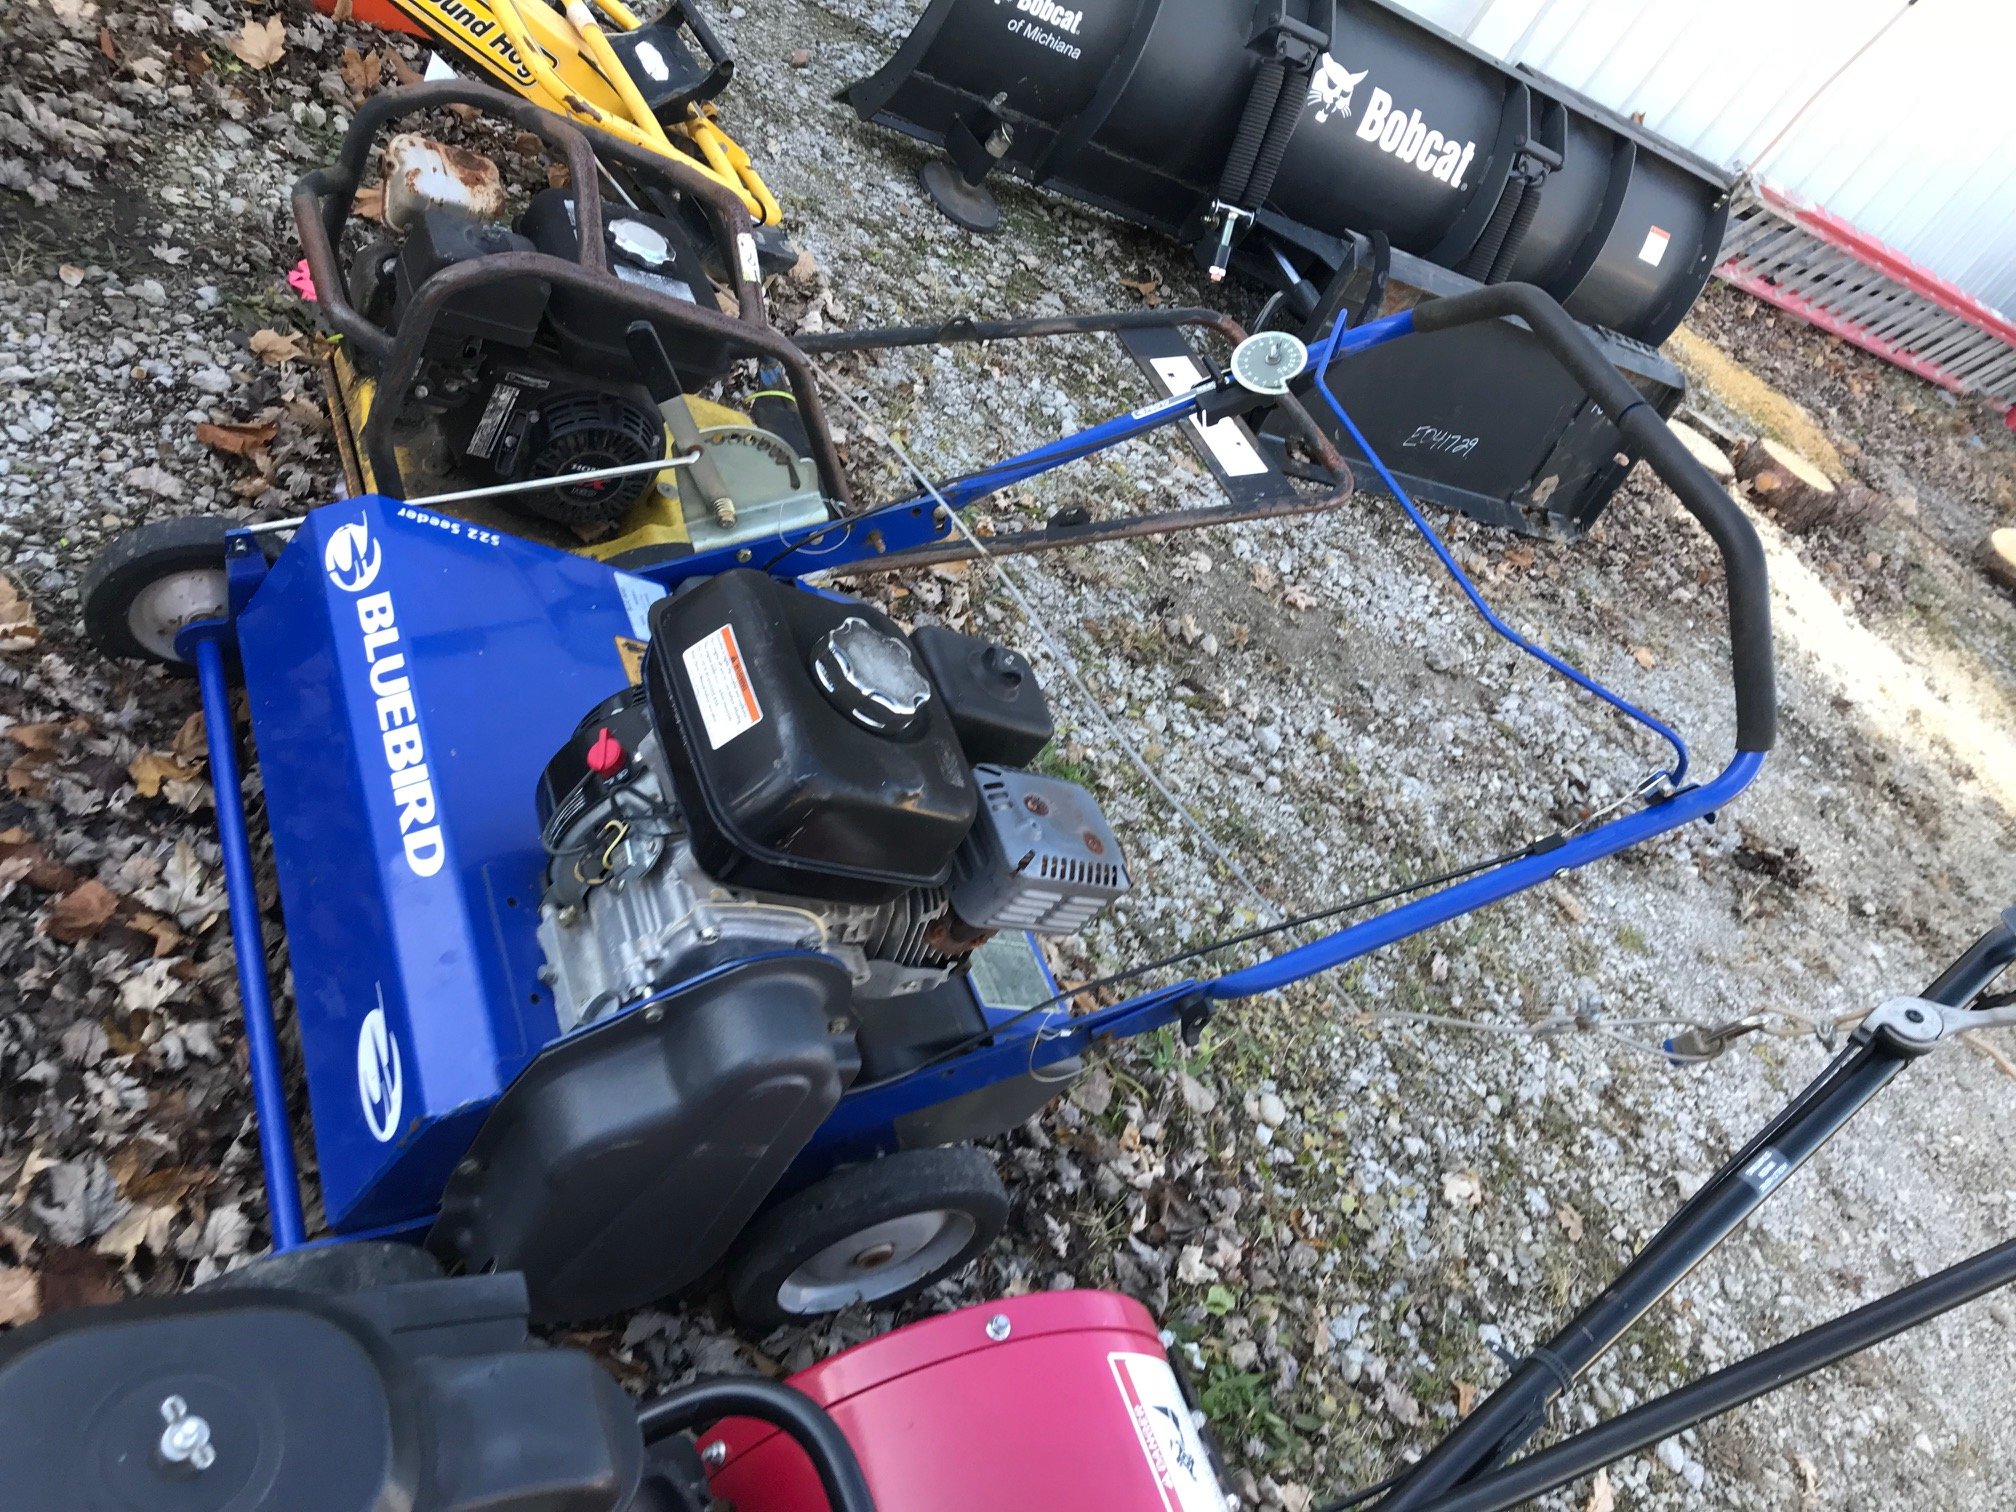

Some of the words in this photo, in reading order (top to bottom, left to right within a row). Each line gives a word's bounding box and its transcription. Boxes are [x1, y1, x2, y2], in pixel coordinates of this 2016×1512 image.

[429, 0, 496, 37] und
[1007, 19, 1025, 33] of
[1022, 23, 1082, 60] Michiana
[1355, 86, 1477, 189] Bobcat
[397, 507, 461, 535] Seeder
[356, 590, 446, 878] BLUEBIRD
